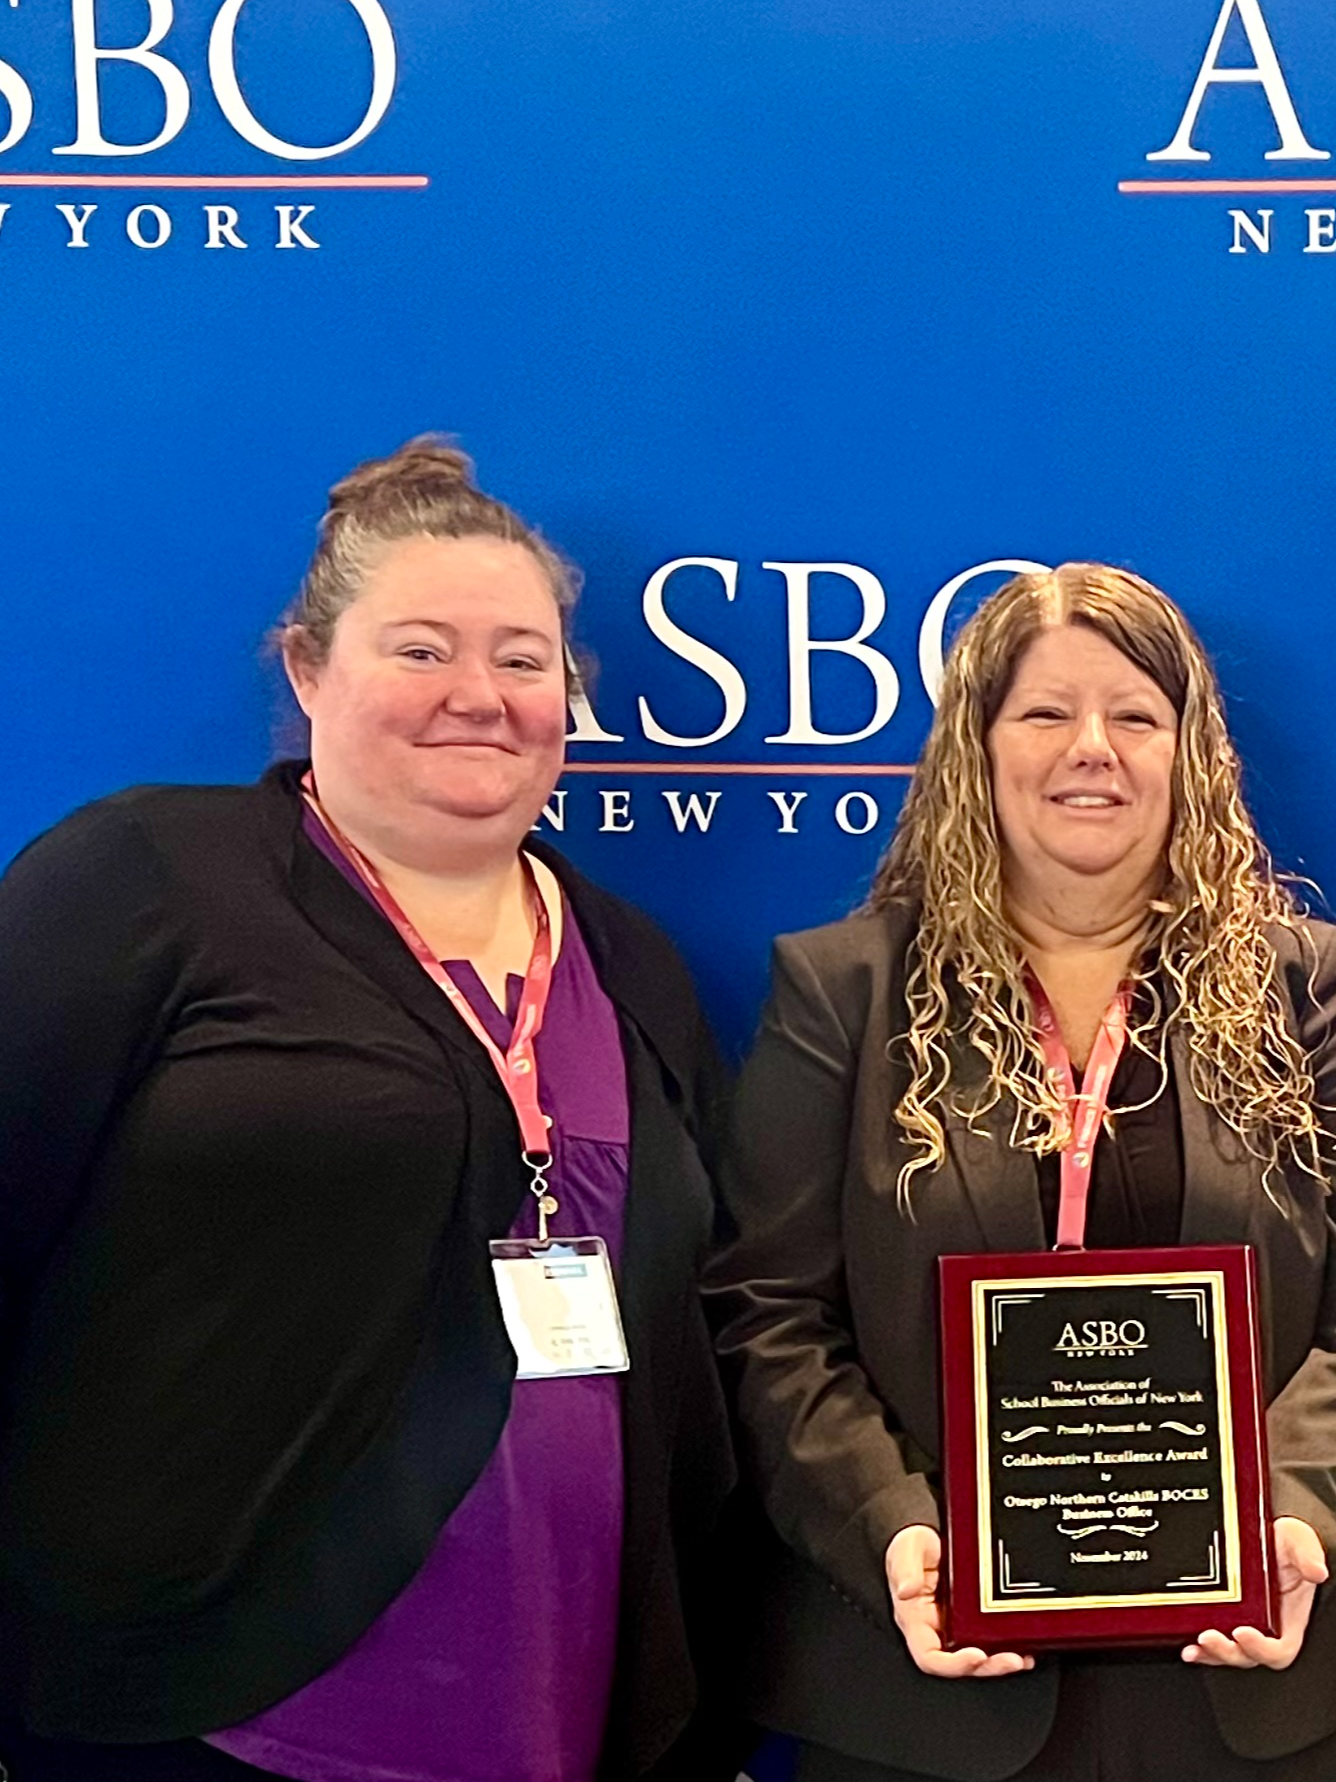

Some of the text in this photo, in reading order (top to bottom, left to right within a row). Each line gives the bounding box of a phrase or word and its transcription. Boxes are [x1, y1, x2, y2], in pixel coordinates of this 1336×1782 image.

[56, 204, 320, 249] YORK
[766, 791, 879, 835] YO
[1056, 1319, 1146, 1347] ASBO
[1051, 1377, 1151, 1392] The Association of
[1001, 1390, 1204, 1409] School Business Officials of New York
[1002, 1447, 1208, 1467] Collaborative Excellence Award
[1004, 1488, 1209, 1509] Otsego Northern Catskills BOCES
[1062, 1505, 1153, 1520] Business Office
[1070, 1550, 1148, 1563] November 2024
